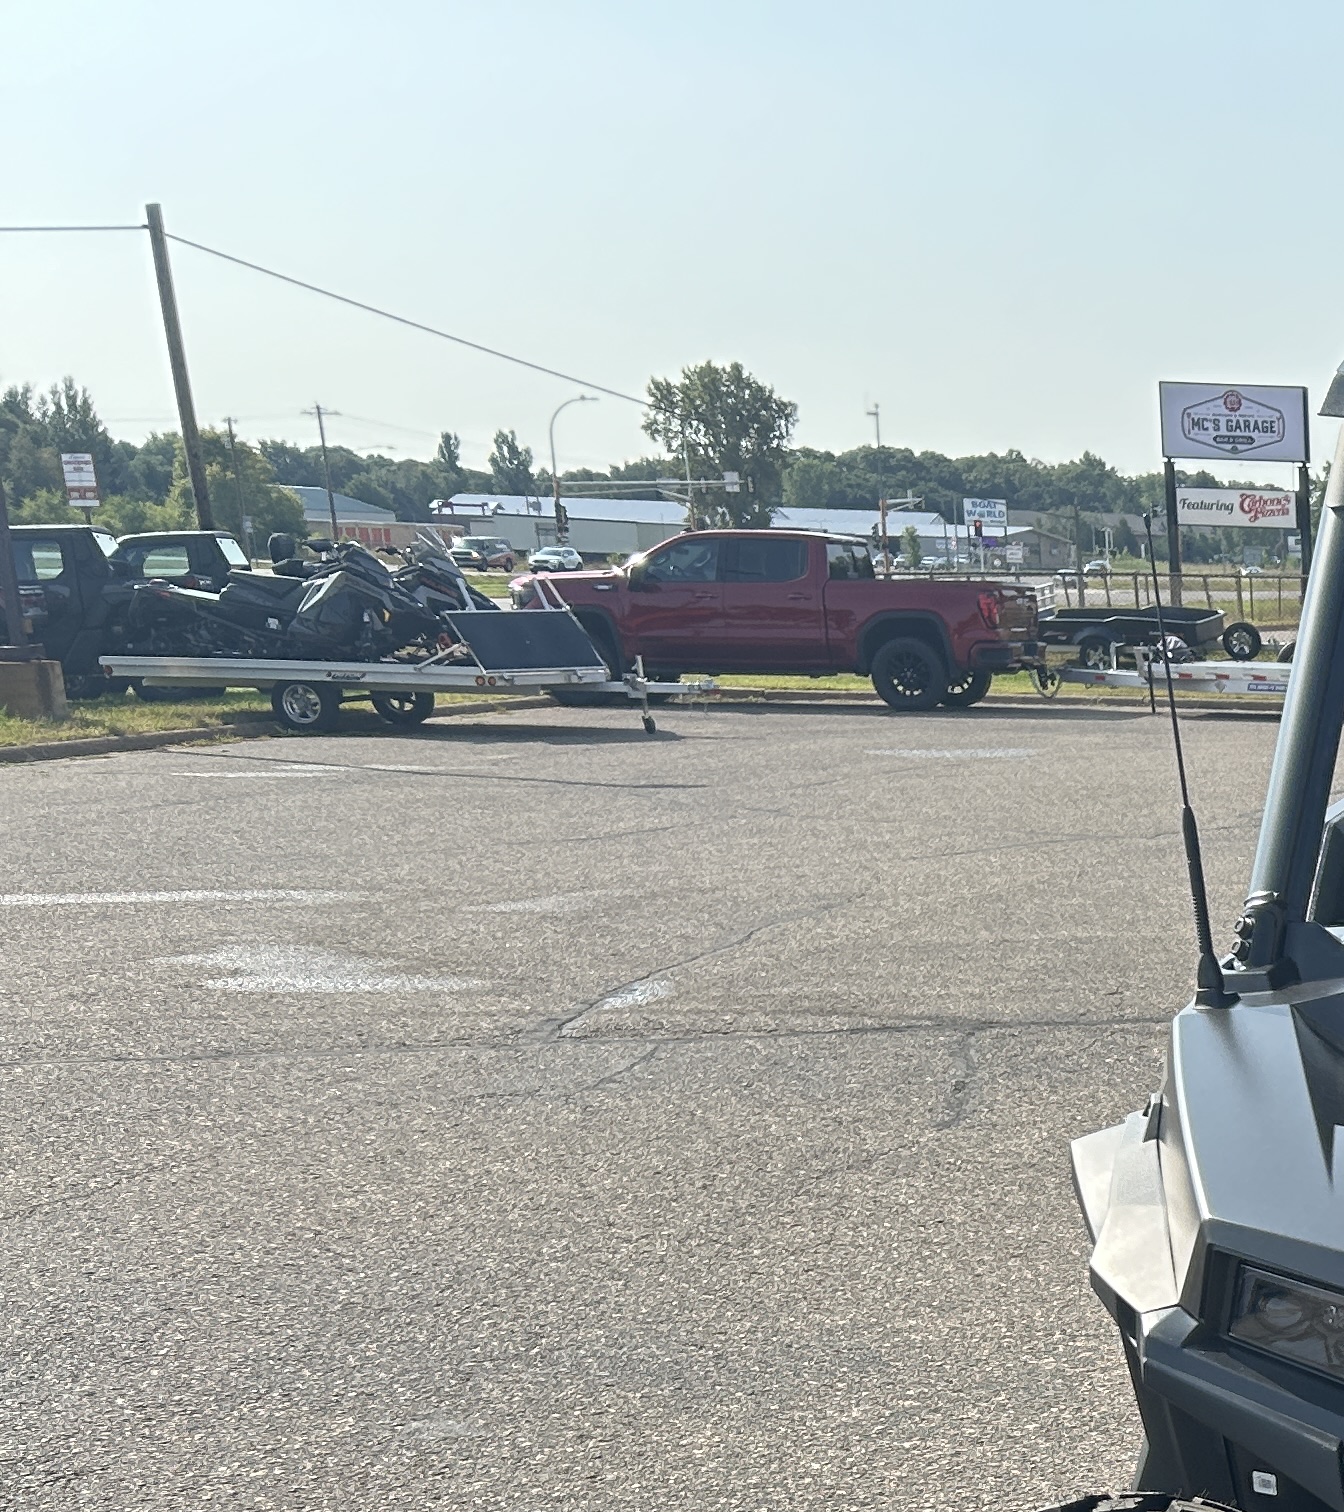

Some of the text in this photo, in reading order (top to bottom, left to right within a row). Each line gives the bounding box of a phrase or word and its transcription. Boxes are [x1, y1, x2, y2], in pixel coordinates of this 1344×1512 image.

[1191, 417, 1277, 434] MC'S GARAGE
[1179, 498, 1235, 515] Featuring
